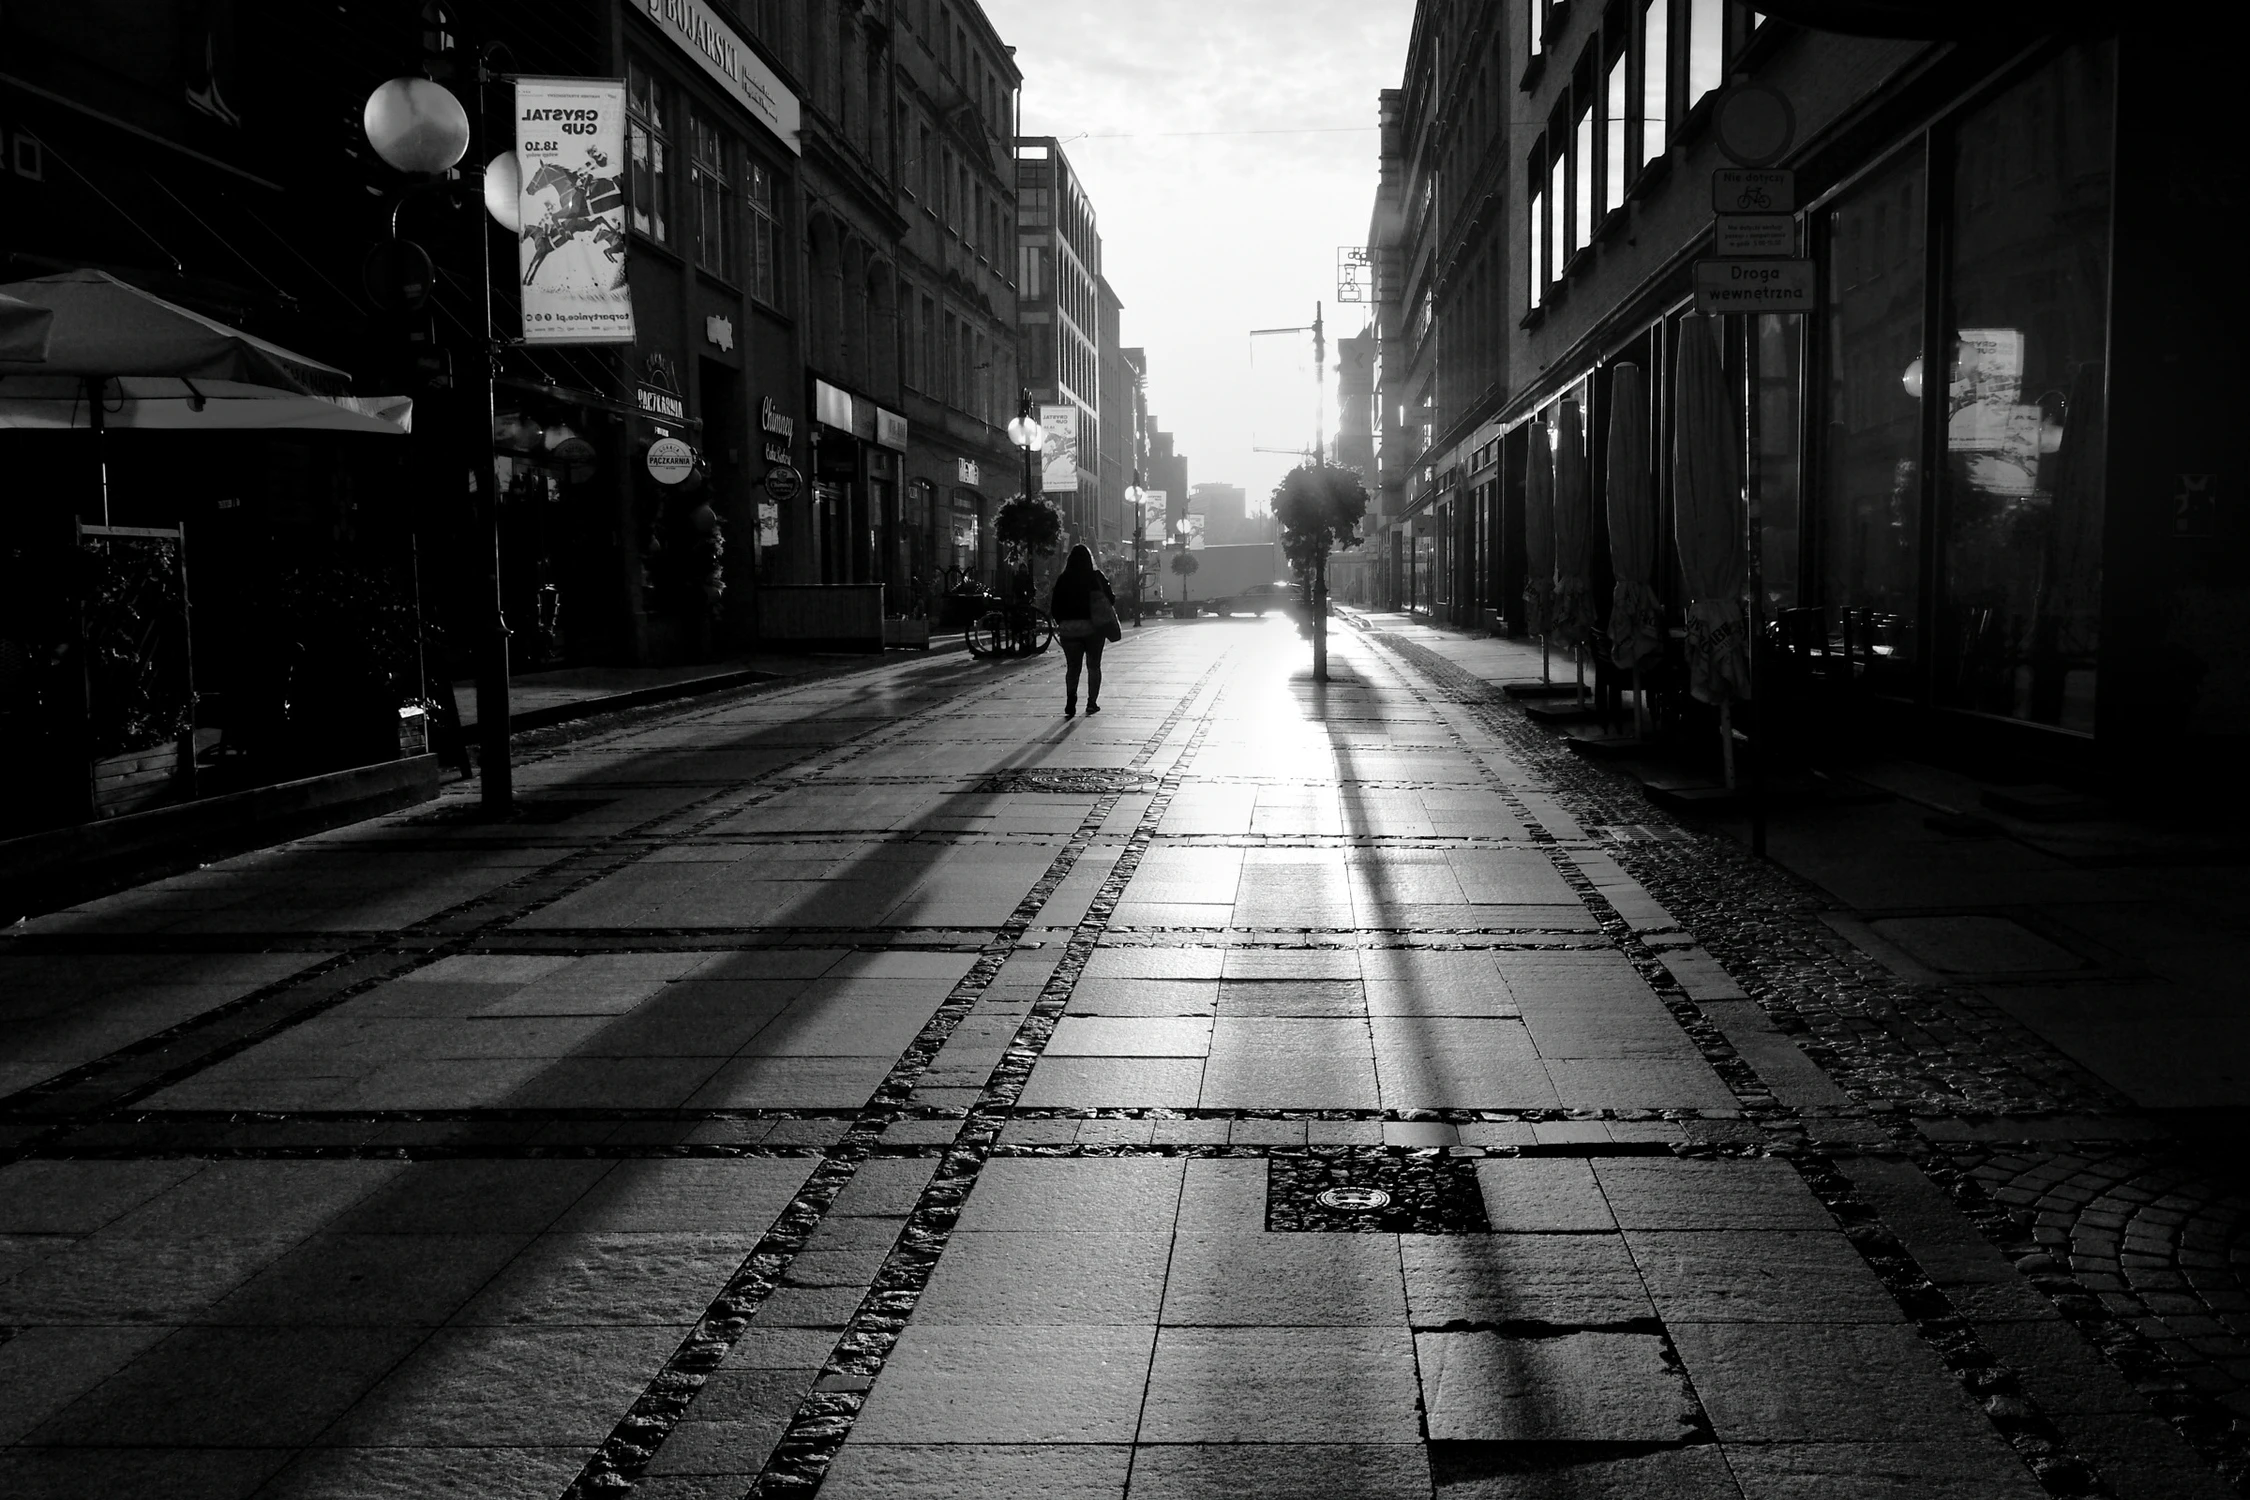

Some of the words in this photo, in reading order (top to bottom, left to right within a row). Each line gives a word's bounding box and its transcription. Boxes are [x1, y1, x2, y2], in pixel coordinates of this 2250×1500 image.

[666, 0, 738, 82] BOJARSKI
[1723, 172, 1742, 183] Nie
[1745, 172, 1785, 186] dotyczy
[1731, 266, 1779, 284] Droga
[1709, 286, 1803, 303] wewnętrzna
[761, 395, 794, 449] Chimney
[649, 457, 690, 466] PĄCZKARNIA
